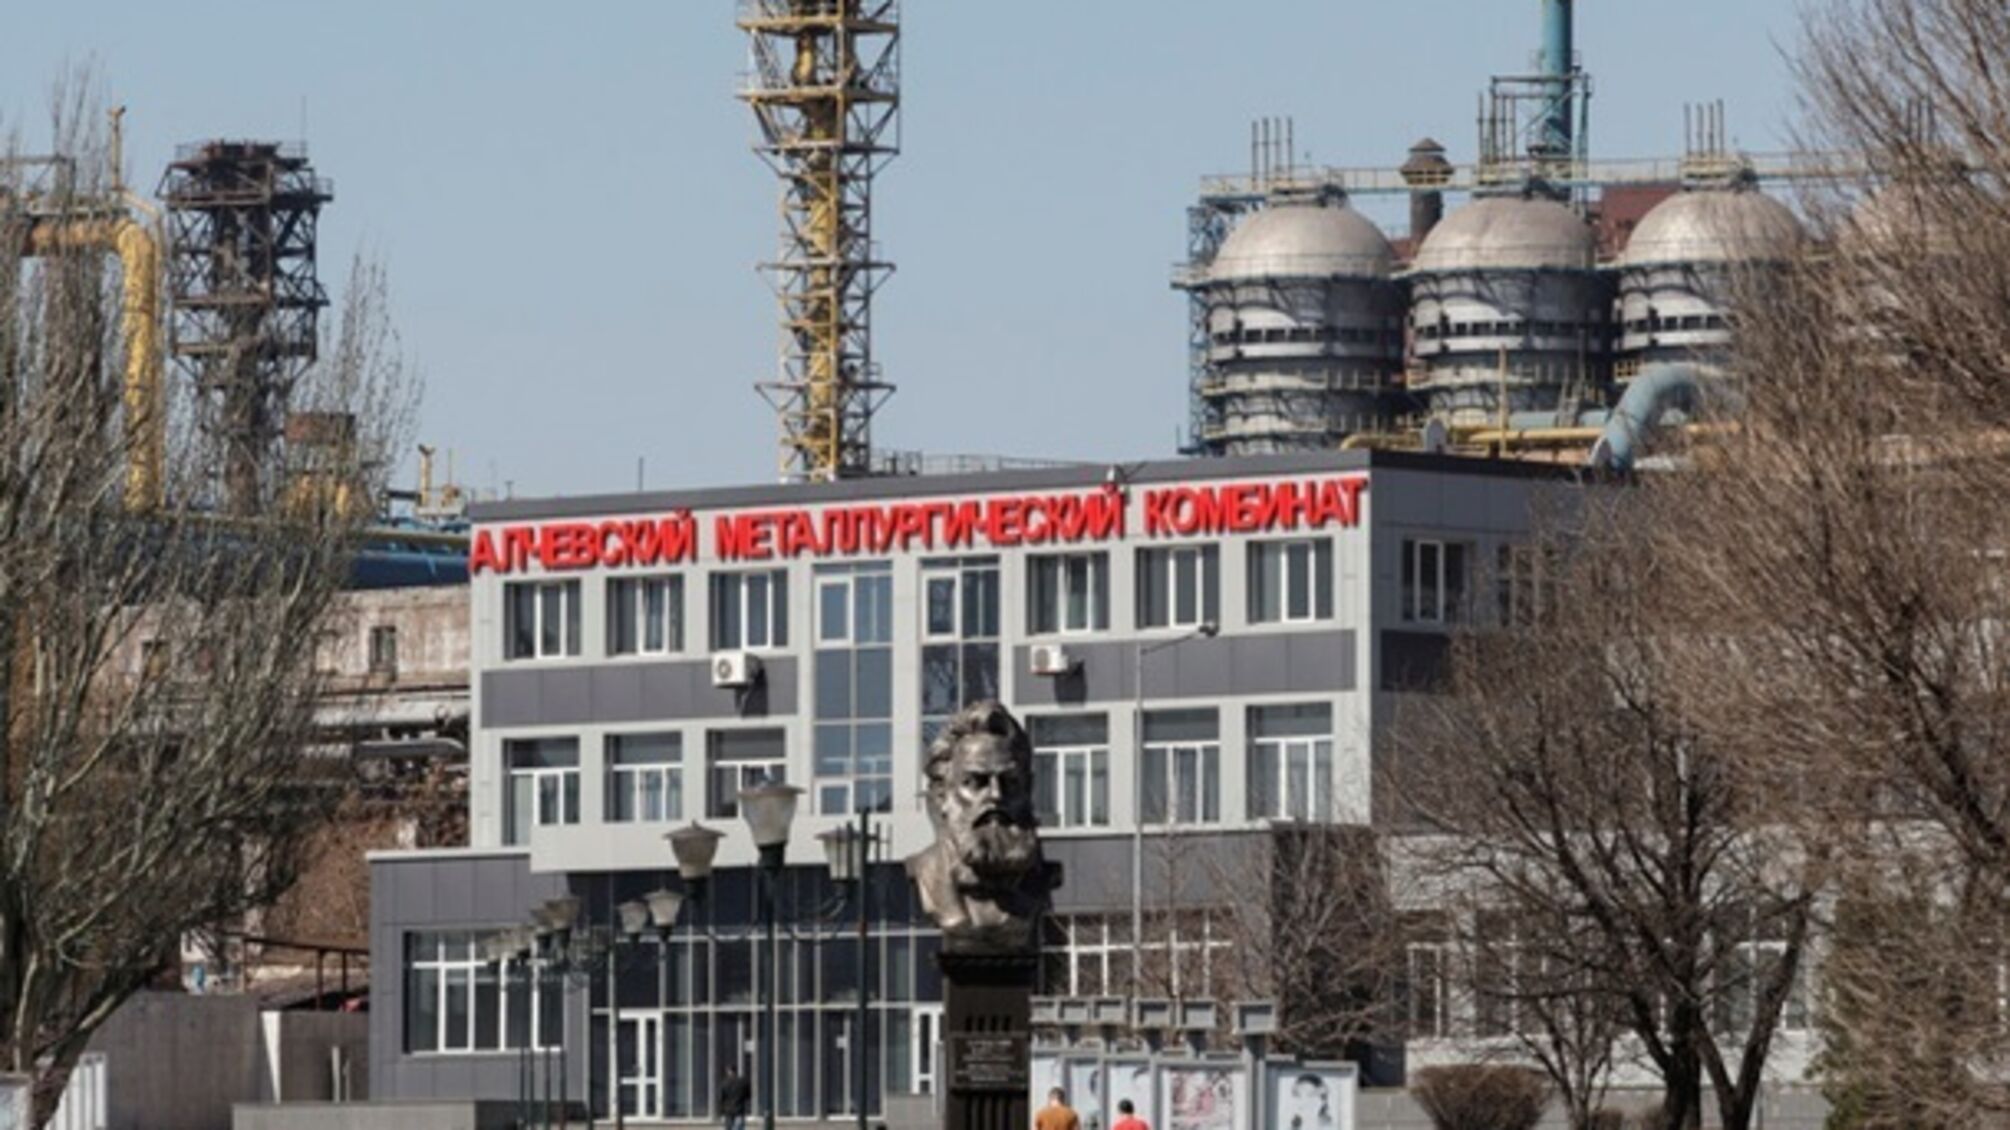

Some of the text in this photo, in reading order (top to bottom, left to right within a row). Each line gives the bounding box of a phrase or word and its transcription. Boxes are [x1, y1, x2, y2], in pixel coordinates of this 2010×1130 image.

[470, 476, 1367, 573] АЛЧЕВСКИЙ МЕТАЛЛУРГИЧЕСКИЙ КОМБИНАТ
